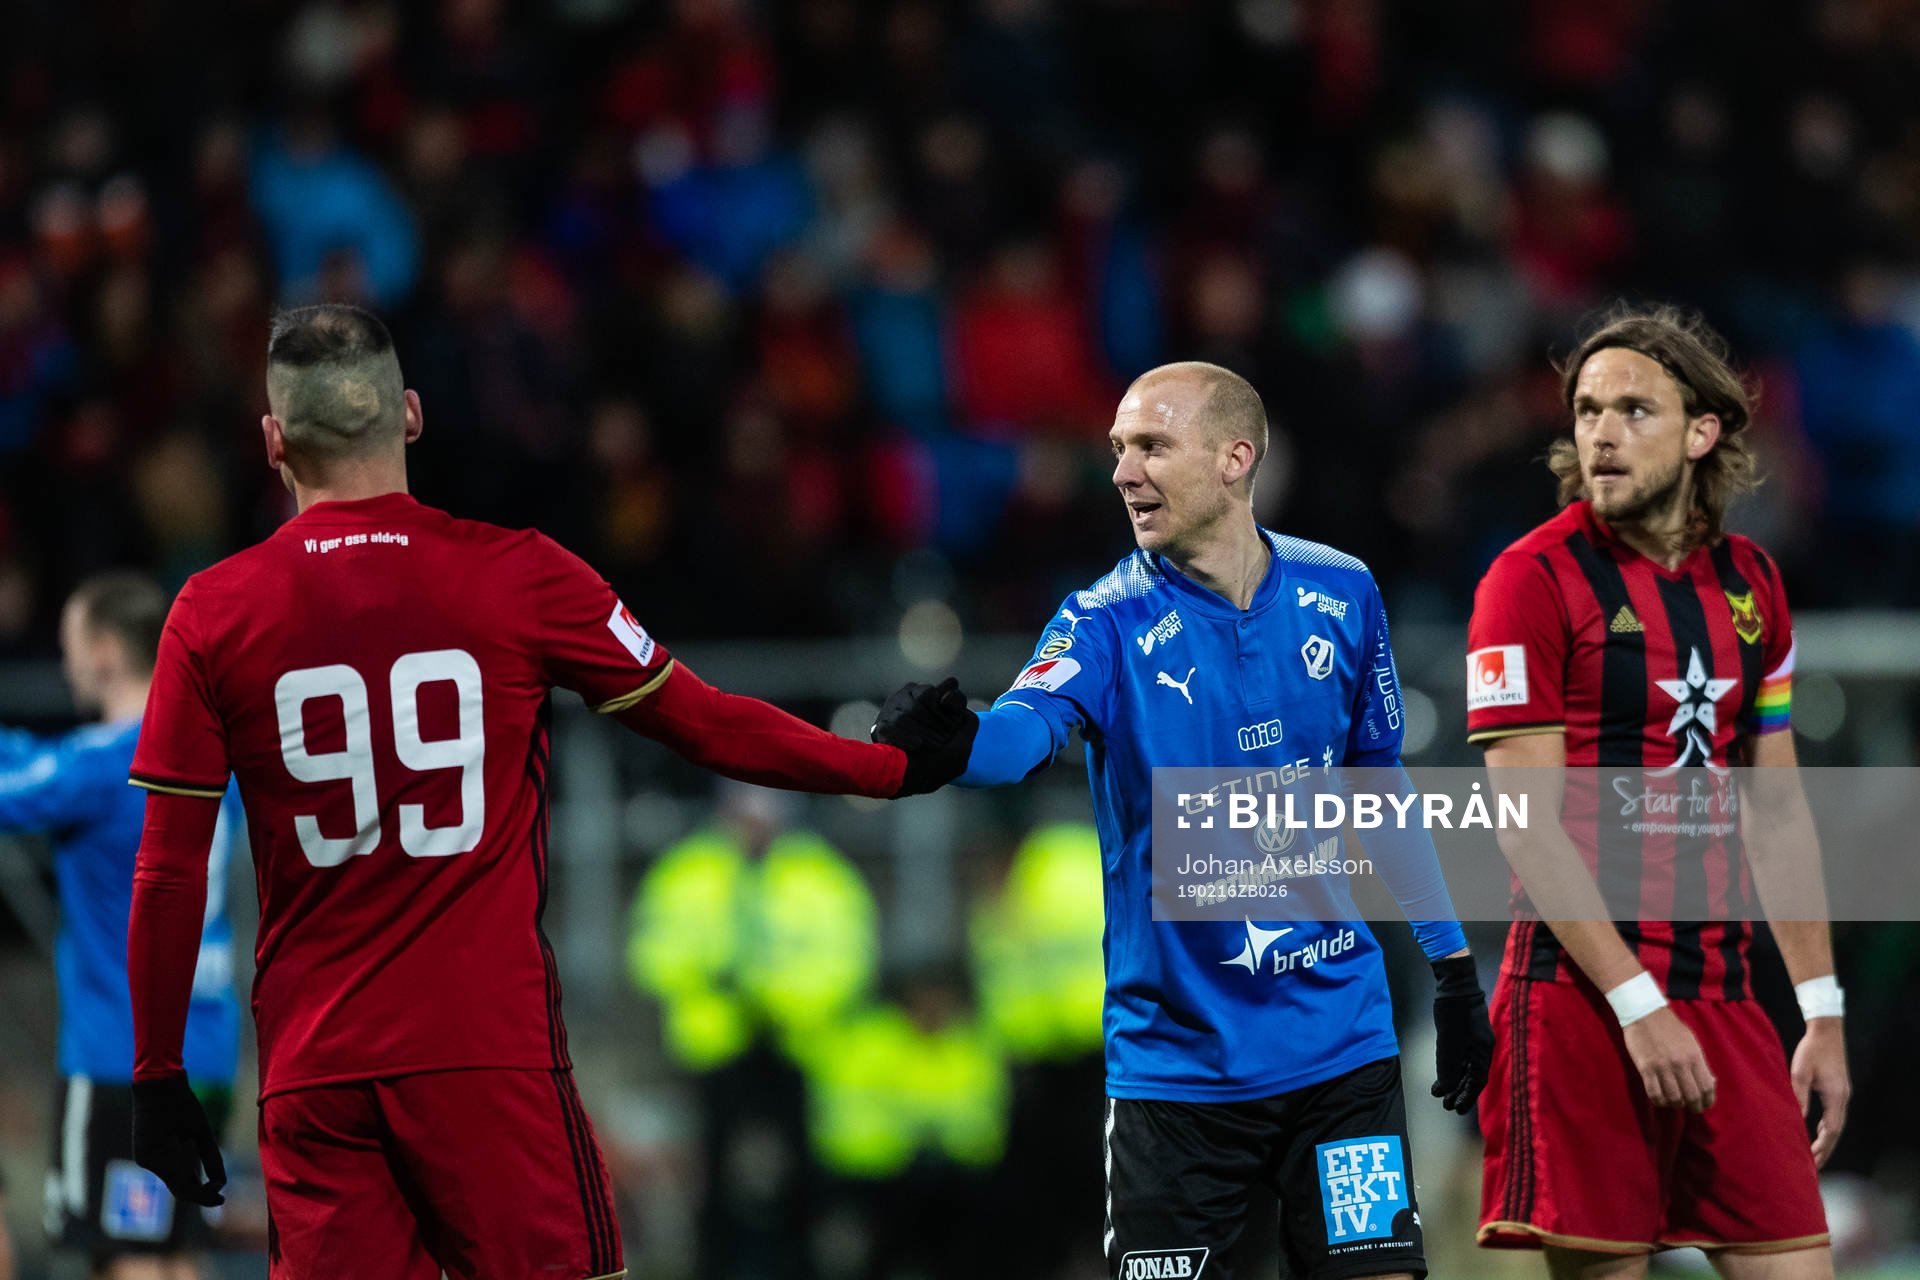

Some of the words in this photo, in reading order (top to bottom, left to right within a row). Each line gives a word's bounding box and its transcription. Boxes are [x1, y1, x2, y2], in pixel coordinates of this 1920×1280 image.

[304, 538, 317, 553] Vi
[320, 537, 342, 553] ger
[345, 533, 367, 546] oss
[370, 532, 409, 546] aldrig
[1317, 602, 1346, 621] SPORT
[1318, 592, 1347, 612] INTER
[1151, 609, 1180, 637] INTER
[1158, 620, 1183, 645] SPORT
[1030, 680, 1052, 690] PEL
[1500, 692, 1524, 701] SPEL
[274, 648, 486, 868] 99
[1612, 776, 1681, 815] Star
[1687, 776, 1712, 817] for
[1631, 822, 1695, 837] empowering
[1697, 823, 1721, 837] young
[1273, 928, 1355, 975] bravida
[1324, 1142, 1390, 1179] EFF
[1327, 1171, 1400, 1208] EKT
[1126, 1255, 1192, 1280] JONAB
